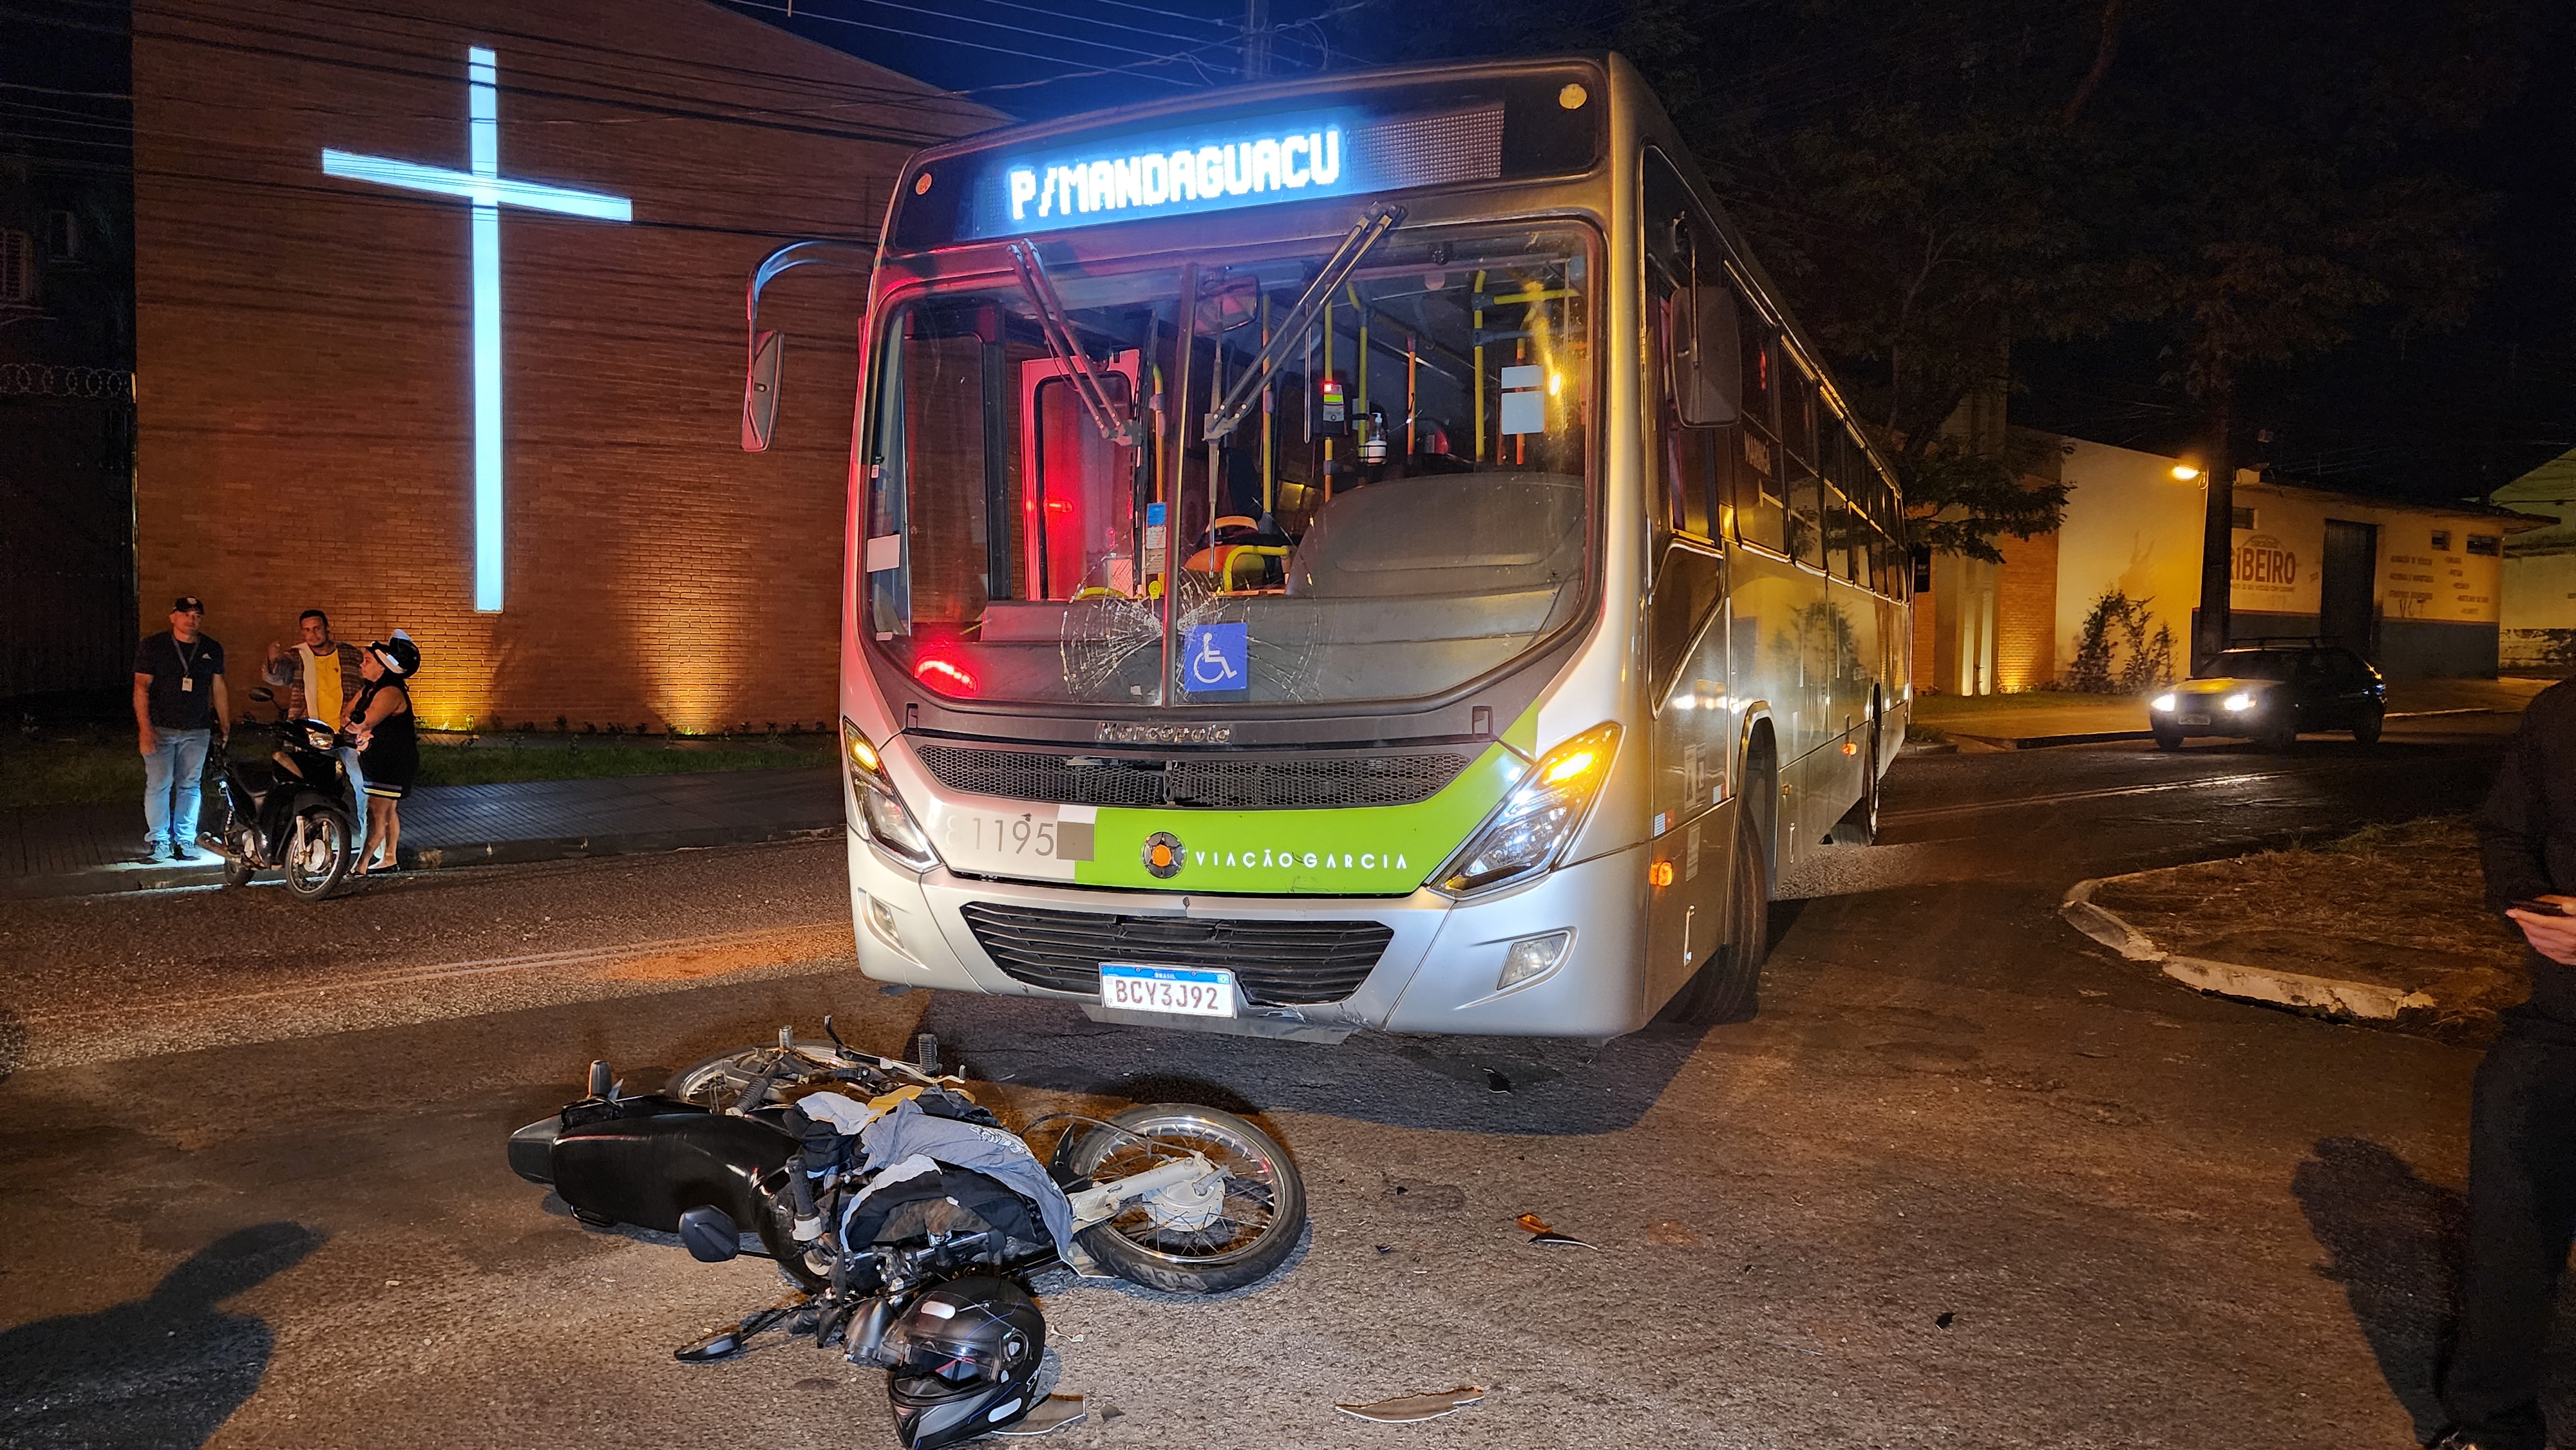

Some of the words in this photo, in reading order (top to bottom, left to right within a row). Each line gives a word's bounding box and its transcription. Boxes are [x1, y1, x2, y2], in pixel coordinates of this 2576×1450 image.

[1010, 129, 1340, 220] P/MANDAGUACU
[1096, 722, 1231, 744] Marcopolo
[1195, 849, 1294, 869] VIAÇÃO
[1303, 852, 1408, 870] GARCIA
[1115, 979, 1218, 1010] BCY3J92
